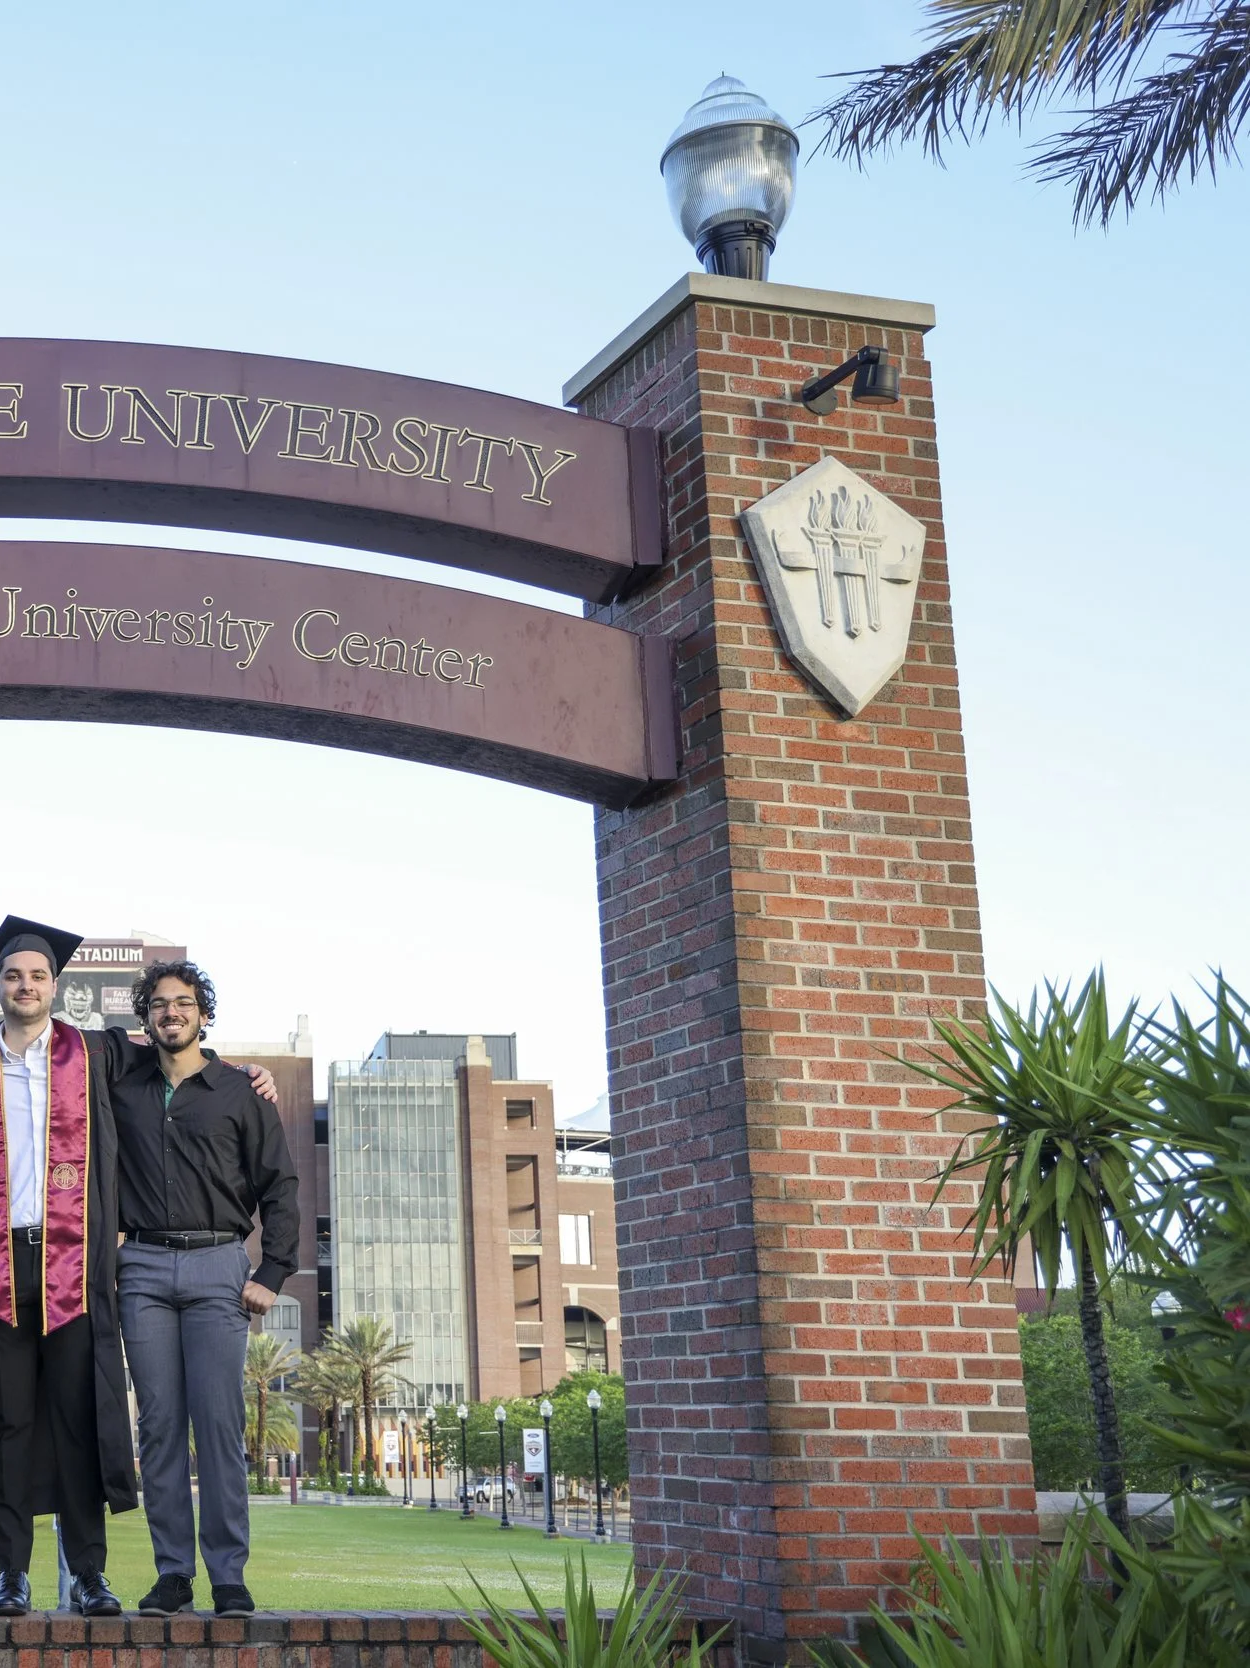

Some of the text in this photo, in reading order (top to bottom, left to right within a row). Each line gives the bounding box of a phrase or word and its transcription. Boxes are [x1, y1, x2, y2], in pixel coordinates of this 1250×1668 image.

[61, 382, 576, 506] UNIVERSITY
[292, 608, 494, 690] Center
[71, 947, 143, 962] STADIUM
